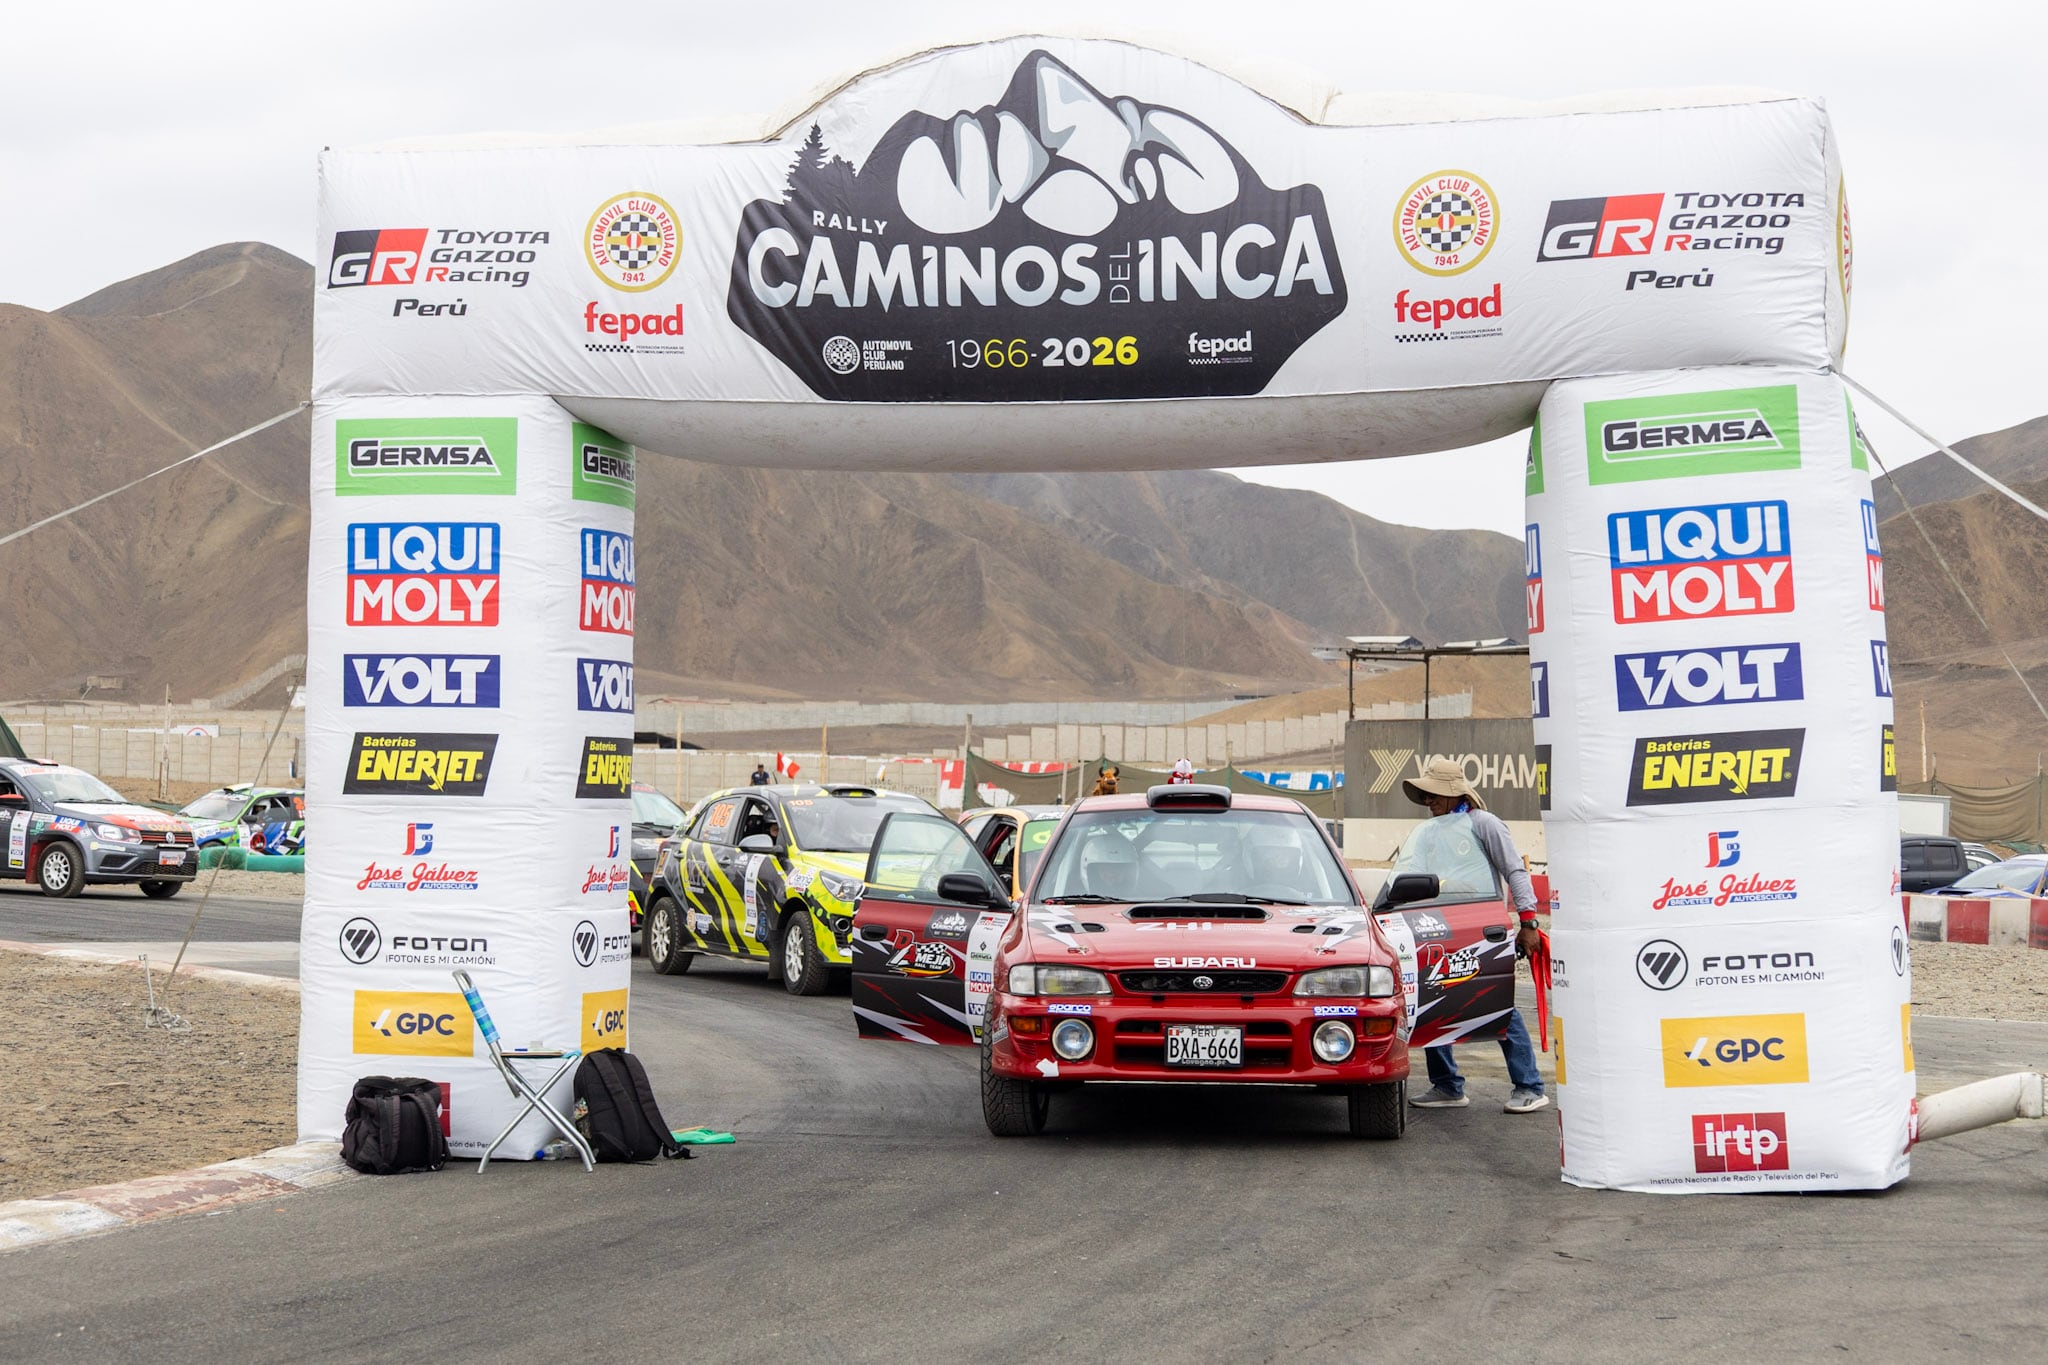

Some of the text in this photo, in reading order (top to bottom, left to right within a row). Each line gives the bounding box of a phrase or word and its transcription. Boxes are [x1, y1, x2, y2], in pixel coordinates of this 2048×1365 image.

[1674, 192, 1804, 209] TOYOTA
[813, 210, 888, 235] RALLY
[1402, 178, 1491, 251] AUTOMOVIL CLUB PERUANO
[1668, 214, 1791, 230] GAZOO
[437, 229, 550, 245] TOYOTA
[593, 200, 675, 267] AUTOMOVIL CLUB PERUANO
[1542, 218, 1654, 259] GR
[1664, 233, 1784, 254] Racing
[430, 248, 536, 263] GAZOO
[1109, 242, 1131, 303] DEL
[1138, 214, 1334, 302] INCA
[1434, 254, 1460, 266] 1942
[329, 251, 418, 286] GR
[425, 266, 530, 288] Racing
[622, 272, 645, 282] 1942
[1625, 268, 1714, 291] Perú
[393, 298, 467, 317] Perú
[1394, 283, 1502, 329] fepad
[584, 301, 684, 342] fepad
[862, 340, 913, 350] AUTOMOVIL
[1188, 330, 1252, 357] fepad
[863, 351, 886, 360] CLUB
[864, 360, 904, 370] PERUANO
[1603, 420, 1773, 452] GERMSA
[350, 440, 494, 467] GERMSA
[1616, 504, 1782, 564] LIQUI
[353, 525, 493, 573] LIQUI
[352, 577, 497, 622] MOLY
[1620, 561, 1792, 619] MOLY
[352, 657, 490, 705] VOLT
[1626, 648, 1790, 706] VOLT
[357, 750, 484, 792] ENERJET
[1642, 748, 1790, 795] ENERJET
[708, 803, 735, 828] 105
[357, 862, 478, 891] José Gálvez
[582, 864, 606, 894] José
[1652, 872, 1796, 910] José Gálvez
[1670, 892, 1792, 906] BREVETES AUTOESCUELA
[393, 937, 487, 952] FOTON
[424, 956, 436, 964] ES
[438, 956, 450, 964] MI
[452, 955, 496, 965] CAMIÓN!
[1154, 956, 1256, 968] SUBARU
[1703, 952, 1814, 972] FOTON
[970, 972, 992, 982] LIQUI
[970, 982, 993, 993] MOLY
[1696, 972, 1824, 986] ¡FOTON ES MI CAMIÓN!
[1048, 1004, 1092, 1014] sparco
[1314, 1006, 1357, 1016] sparco
[396, 1012, 454, 1036] GPC
[604, 1010, 624, 1033] GPC
[1170, 1038, 1238, 1058] BXA-666
[1716, 1037, 1784, 1063] GPC
[1705, 1122, 1778, 1164] irtp
[1685, 1176, 1719, 1184] Nacional
[1764, 1172, 1803, 1181] Televisión
[1806, 1172, 1818, 1180] del
[1820, 1172, 1839, 1180] Perú
